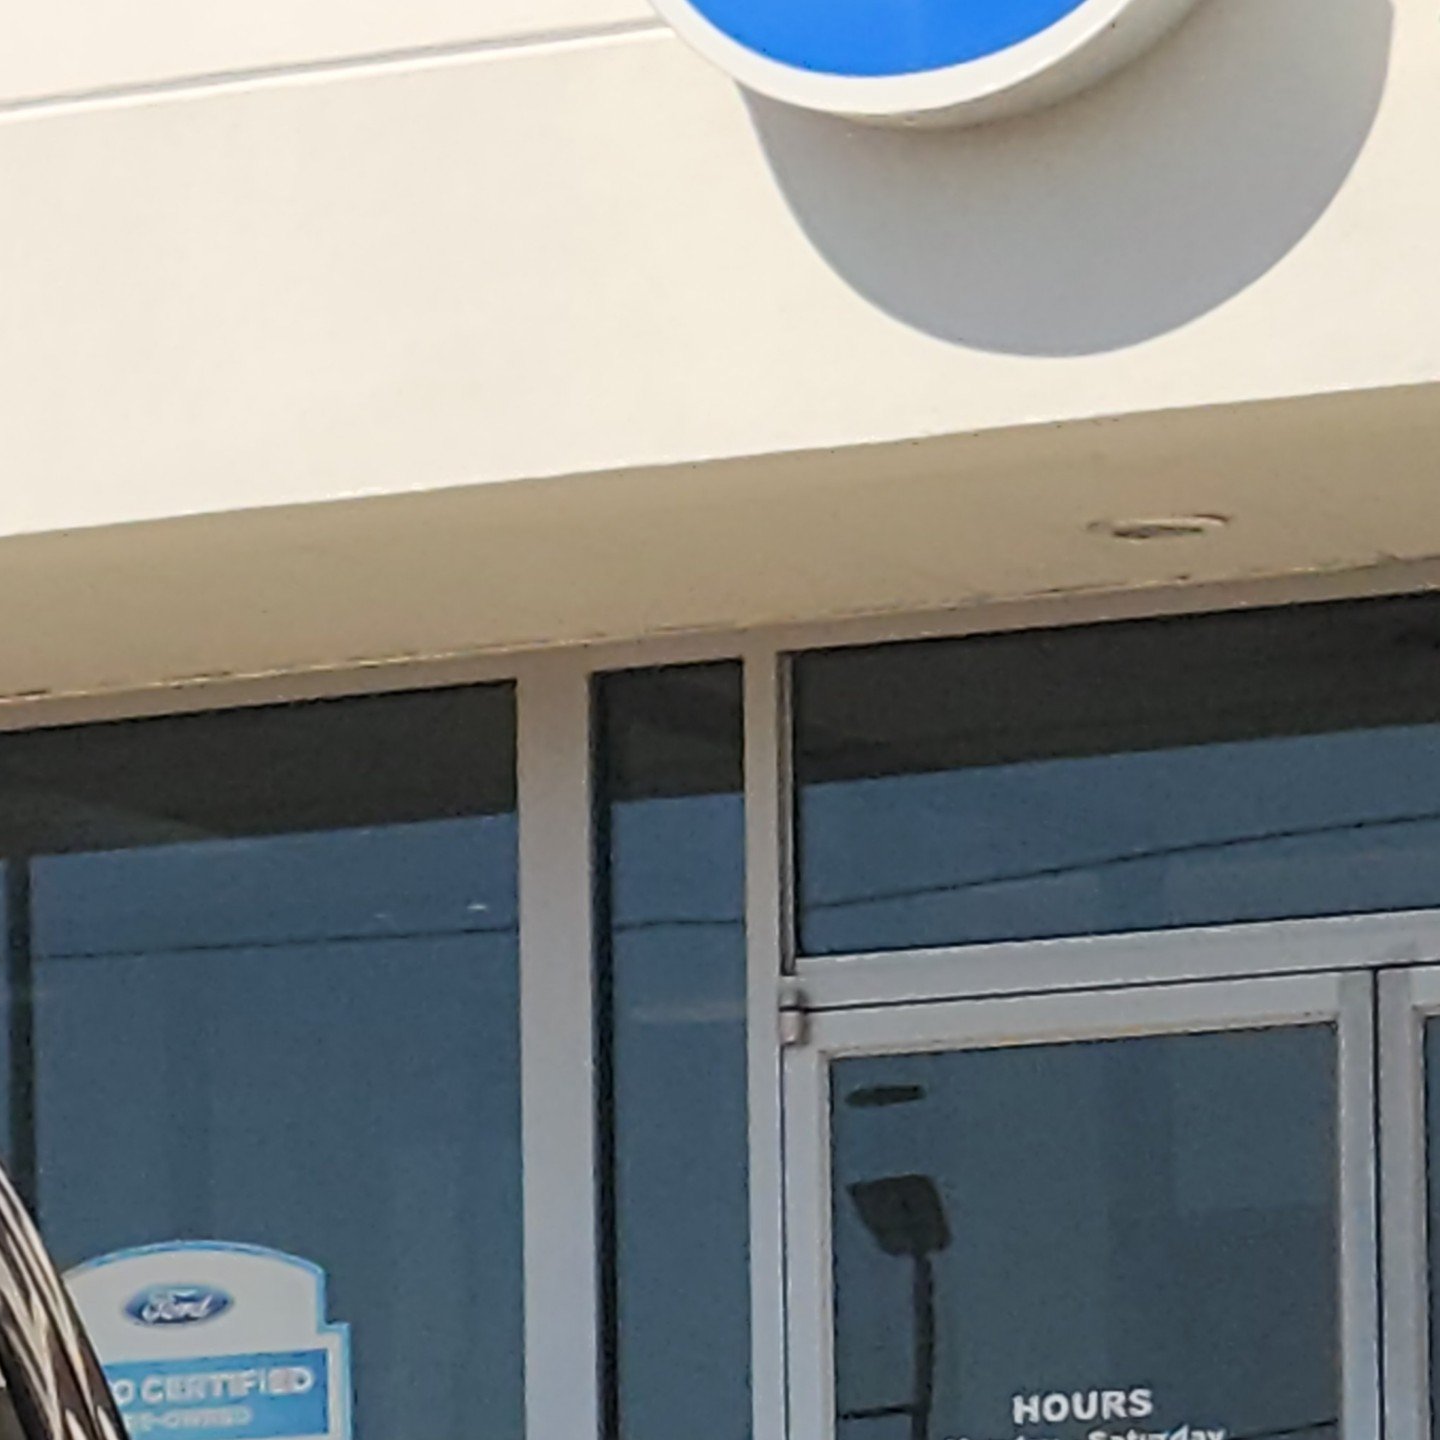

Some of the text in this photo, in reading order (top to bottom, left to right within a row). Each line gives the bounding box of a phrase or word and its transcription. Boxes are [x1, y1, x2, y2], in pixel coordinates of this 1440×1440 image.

[141, 1287, 214, 1322] Ford
[108, 1367, 313, 1405] O CERTIFIED
[1013, 1389, 1153, 1424] HOURS
